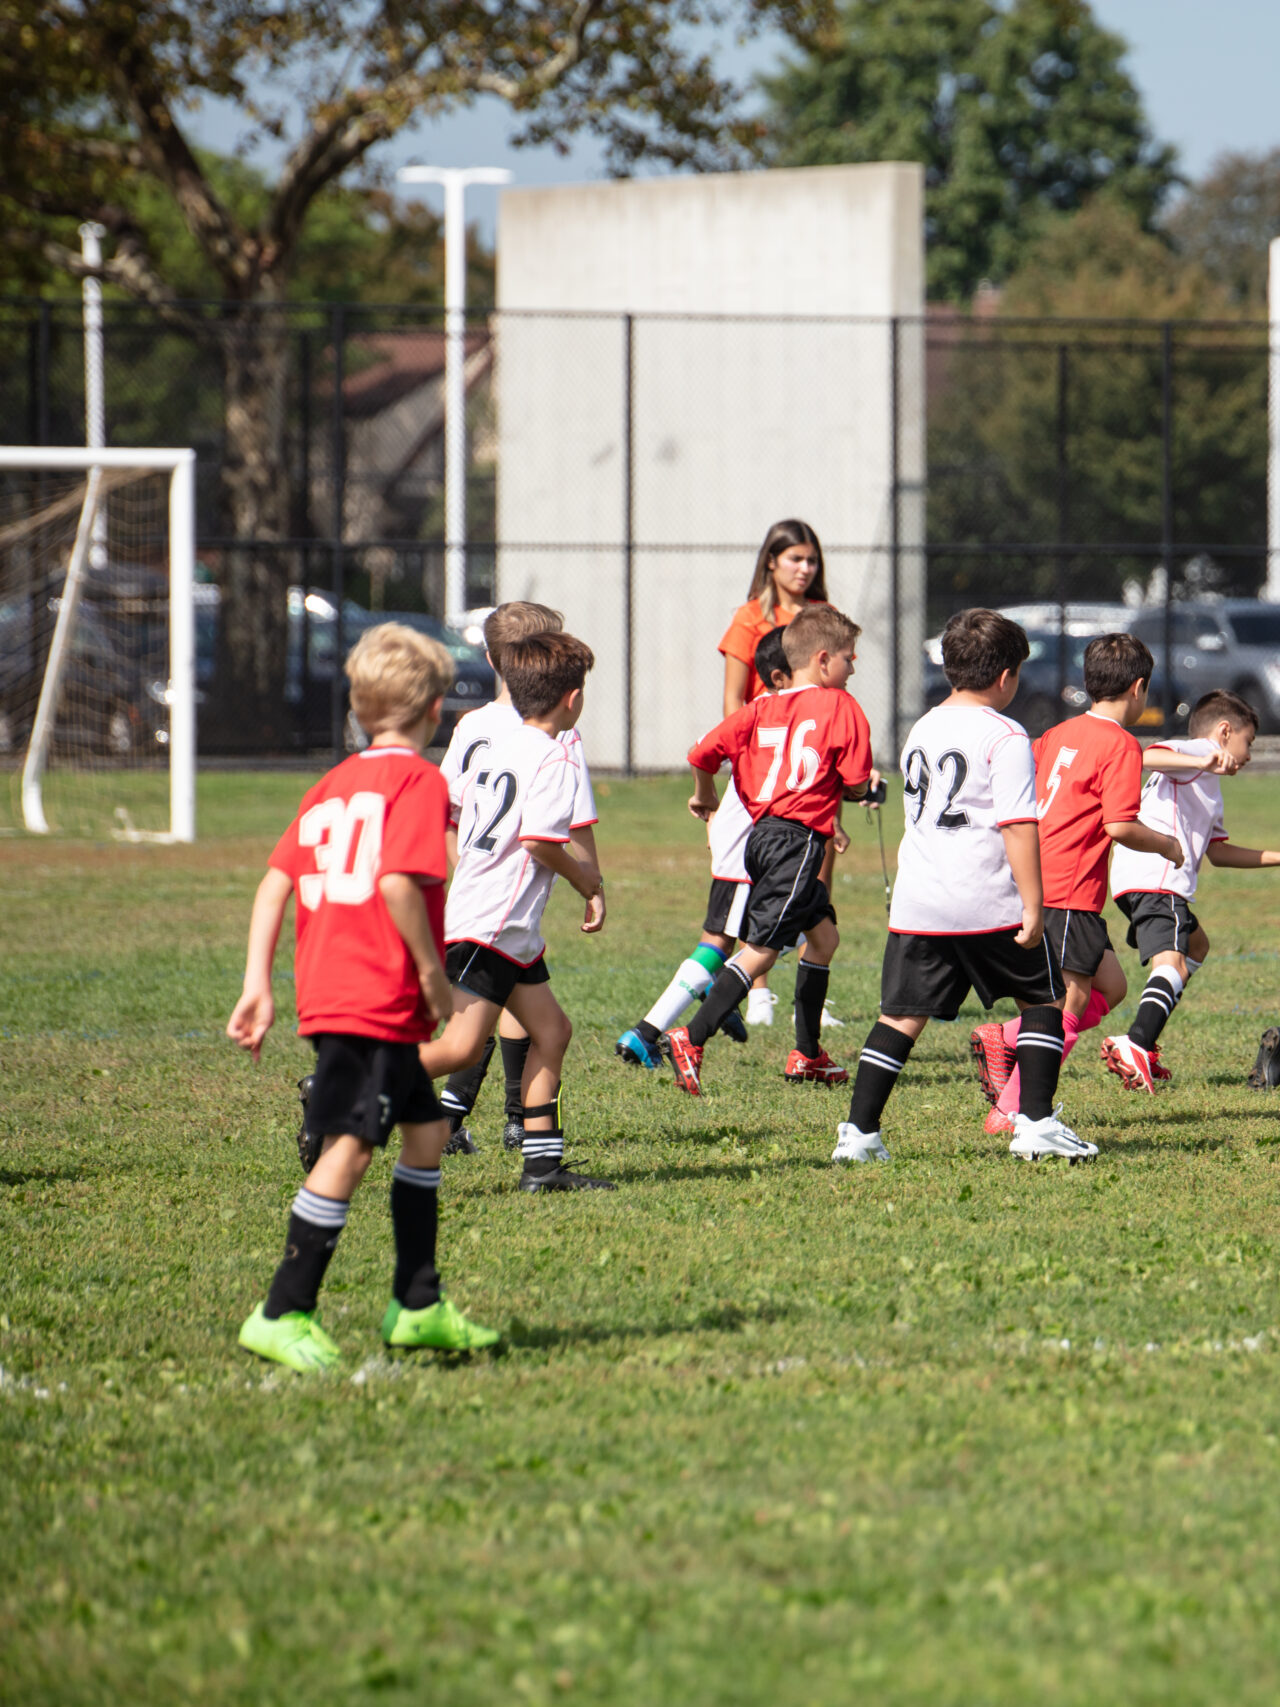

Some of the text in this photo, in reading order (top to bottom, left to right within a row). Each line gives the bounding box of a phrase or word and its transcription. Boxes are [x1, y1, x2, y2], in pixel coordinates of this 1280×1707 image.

[756, 719, 821, 801] 76
[904, 746, 971, 831] 92
[299, 791, 385, 912] 30
